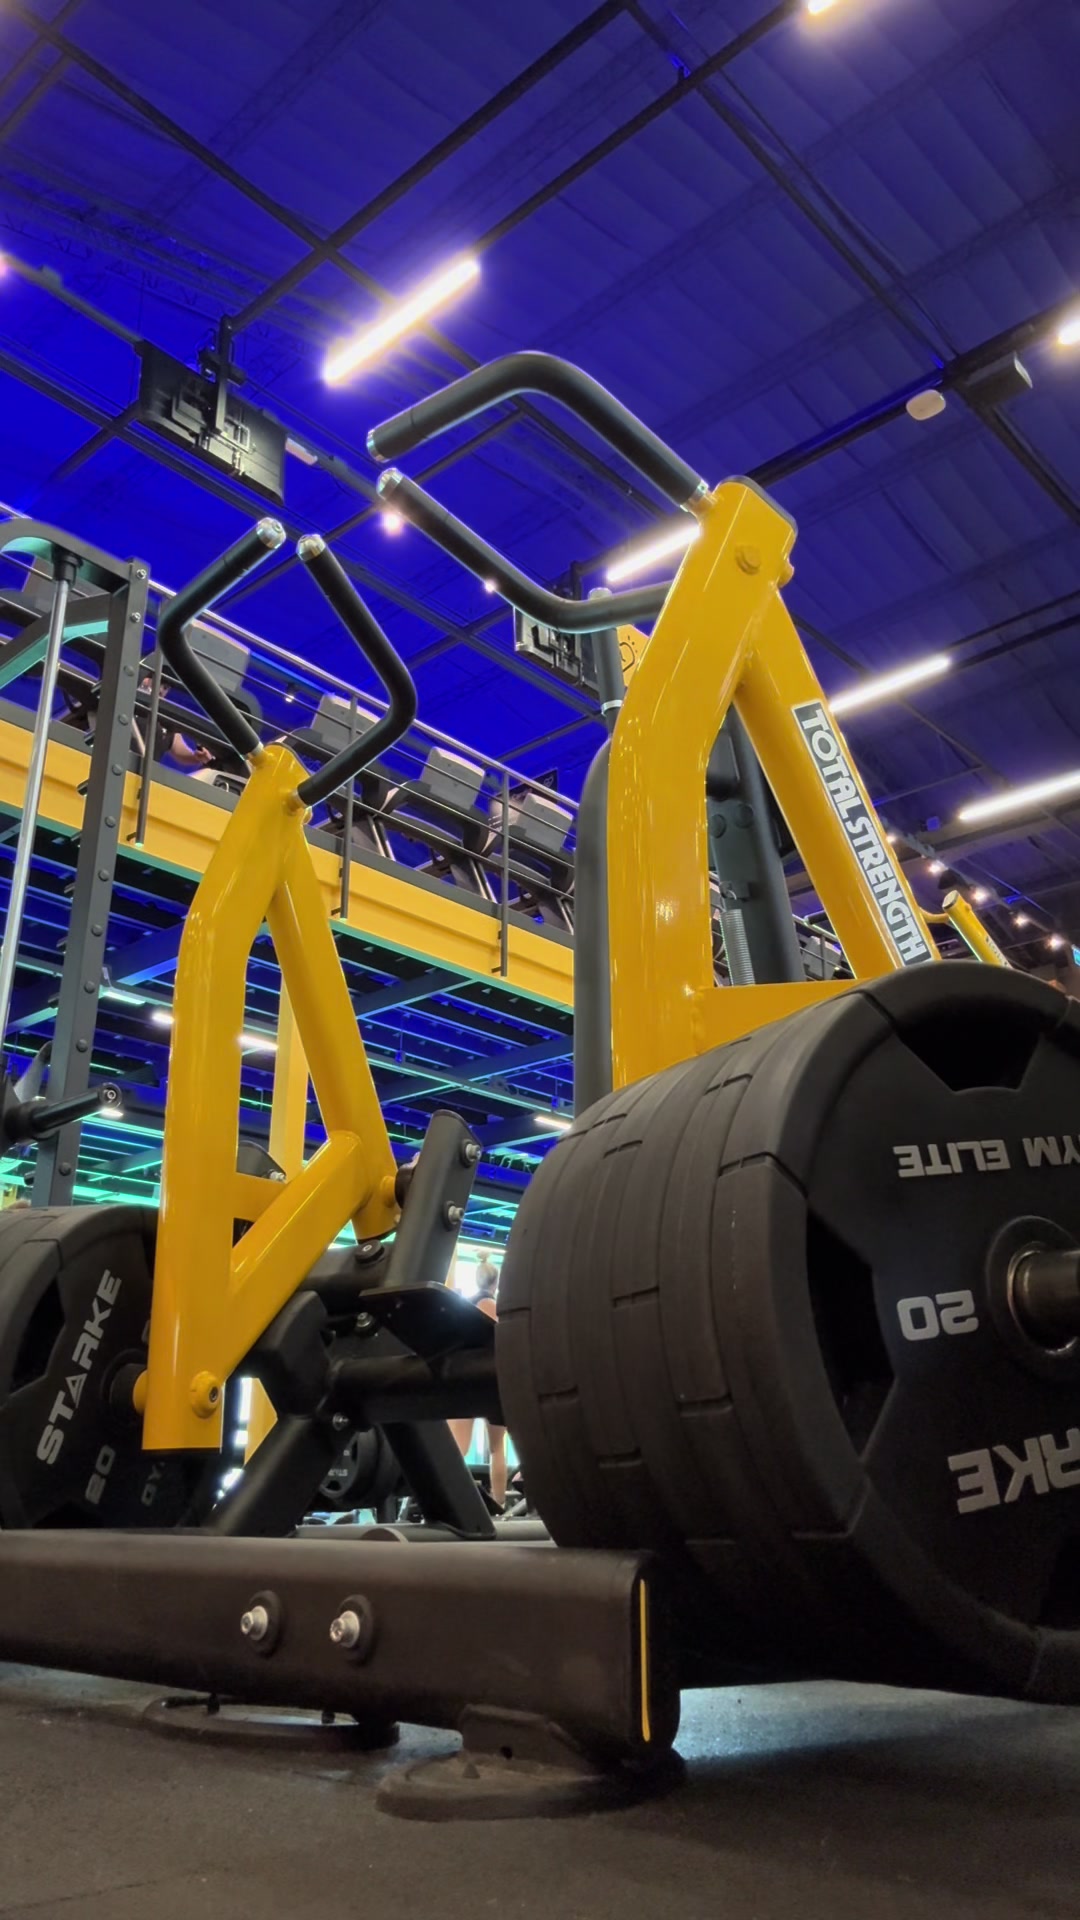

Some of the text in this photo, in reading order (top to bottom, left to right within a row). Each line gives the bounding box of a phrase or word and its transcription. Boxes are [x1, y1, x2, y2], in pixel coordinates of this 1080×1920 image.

[801, 708, 928, 963] TOTAL STRENGTH
[893, 1135, 1080, 1178] YM ELITE
[897, 1289, 979, 1341] 20
[36, 1269, 122, 1465] STARKE
[947, 1427, 1080, 1514] RKE
